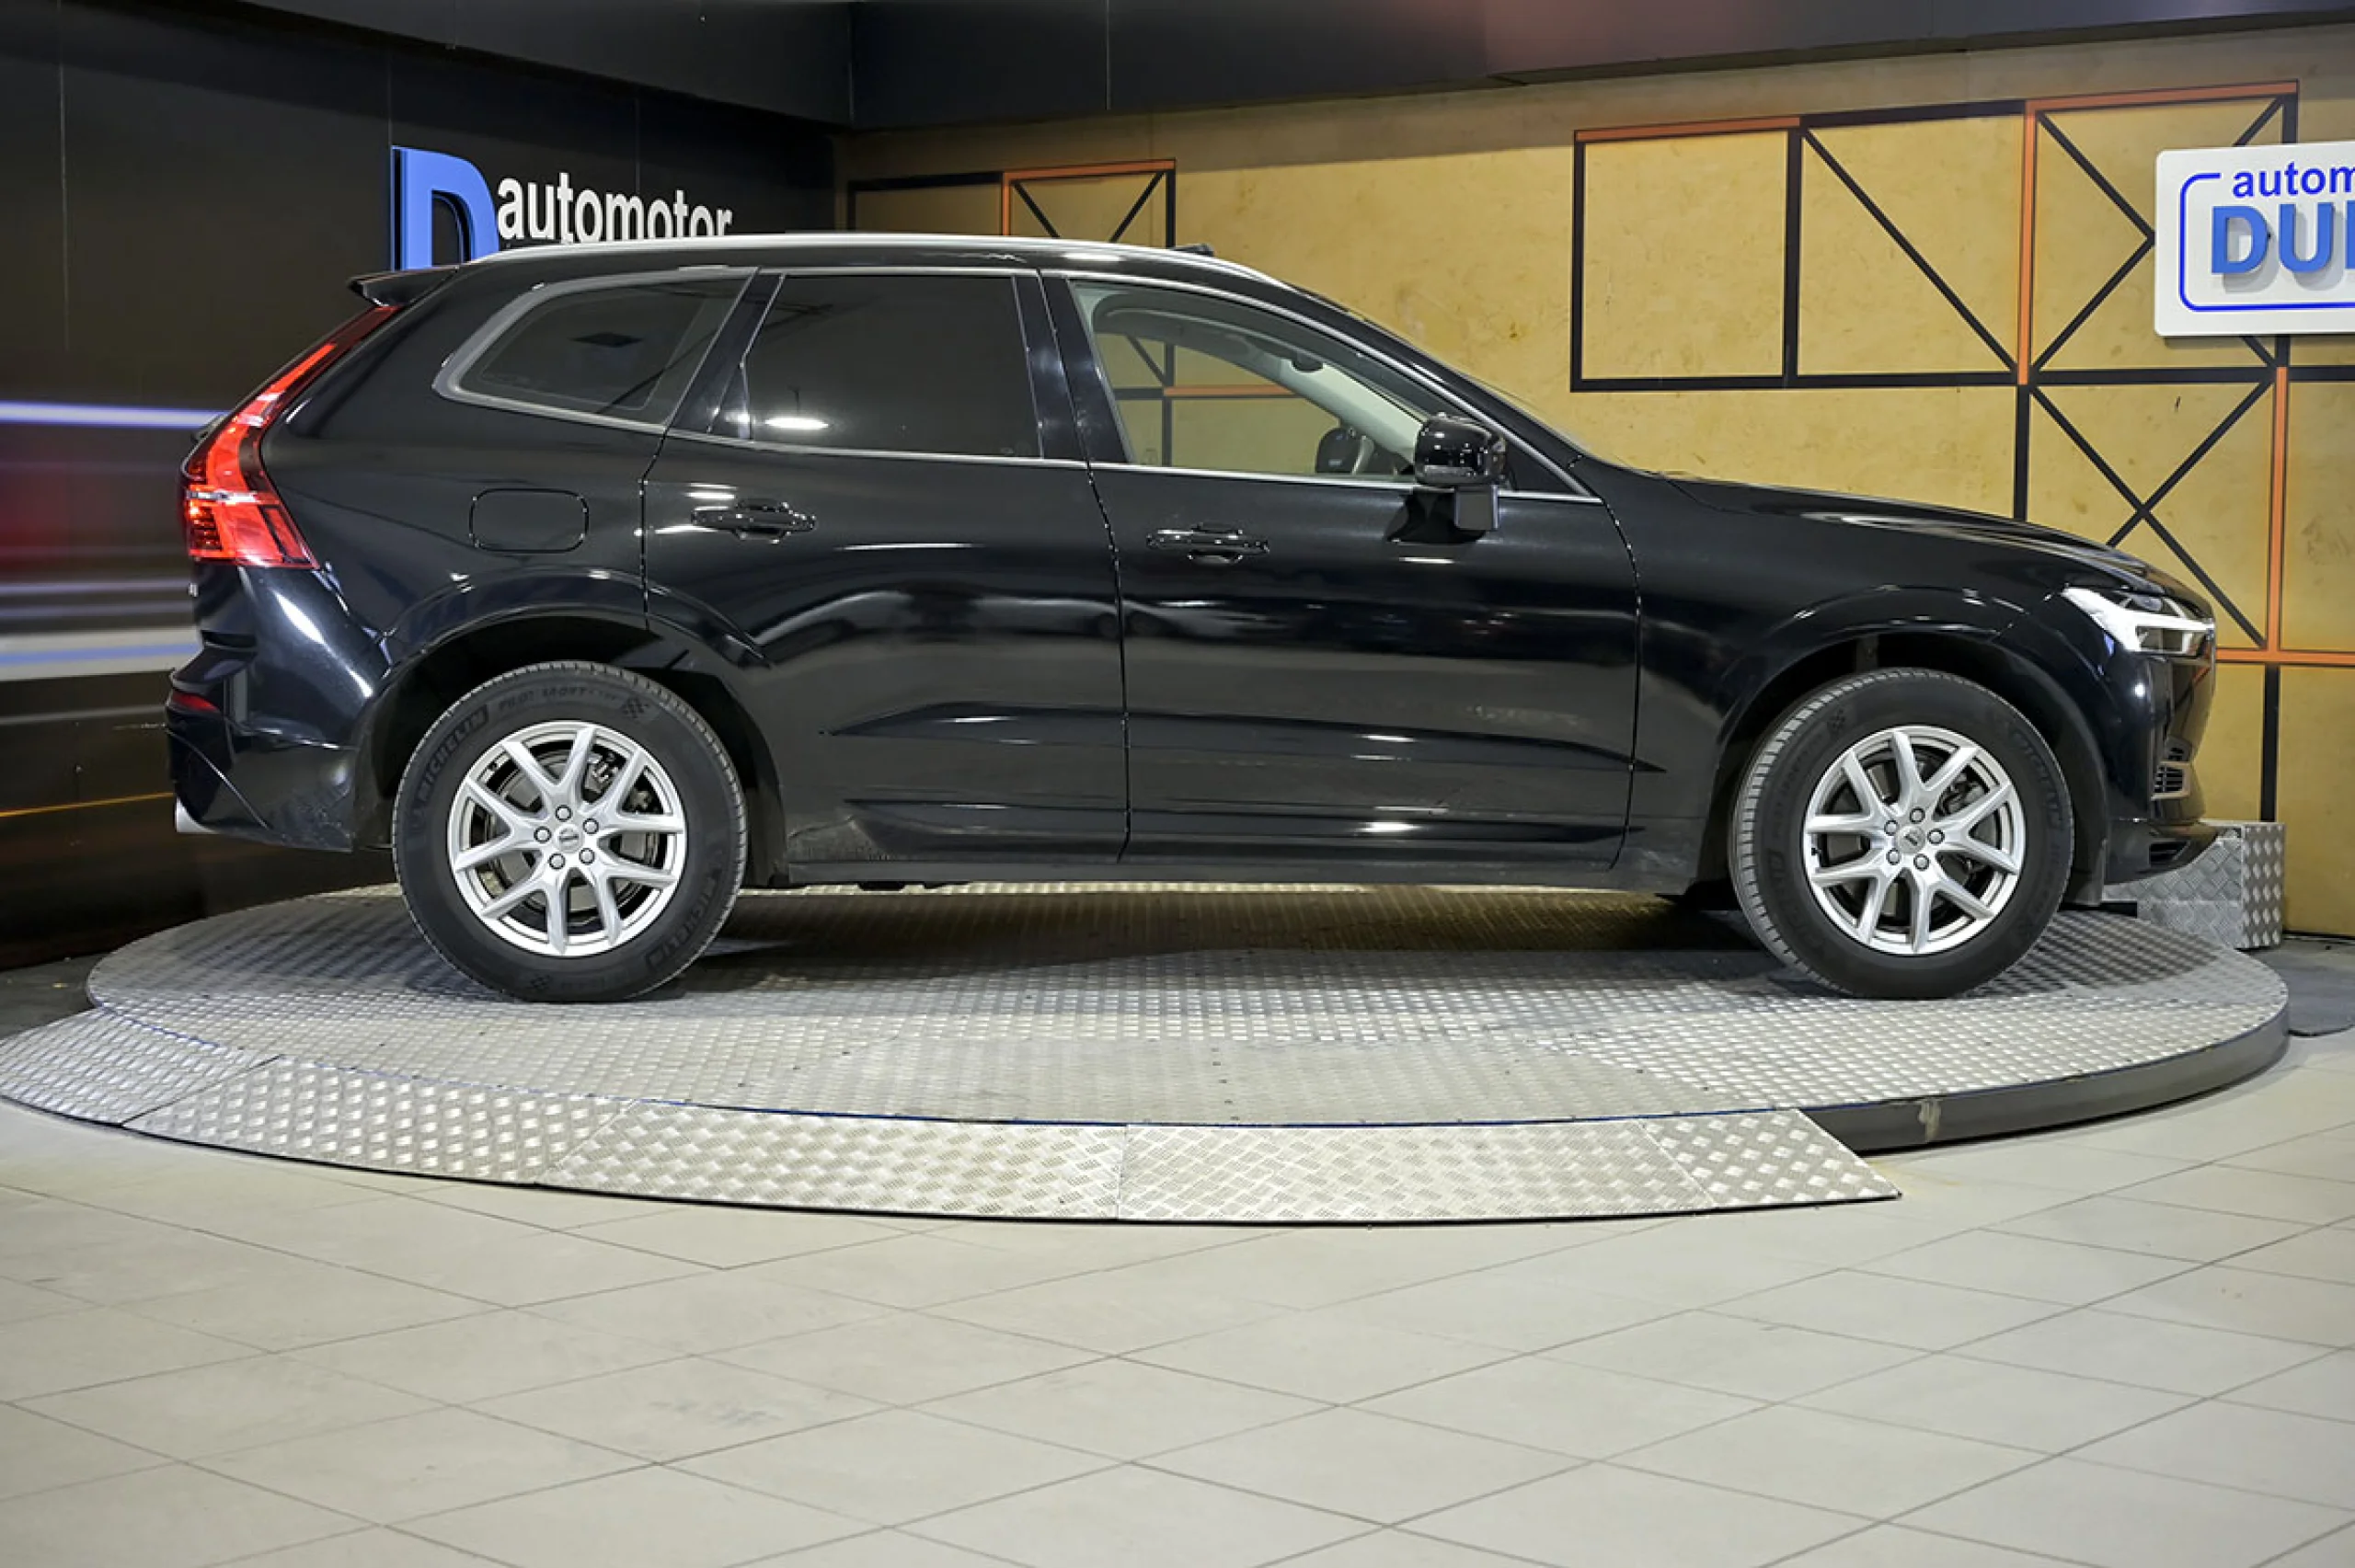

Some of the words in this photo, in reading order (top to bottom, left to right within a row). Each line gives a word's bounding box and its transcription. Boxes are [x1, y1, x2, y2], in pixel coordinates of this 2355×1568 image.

[498, 171, 733, 245] automotor
[2232, 161, 2355, 199] autom
[2211, 199, 2355, 275] DU
